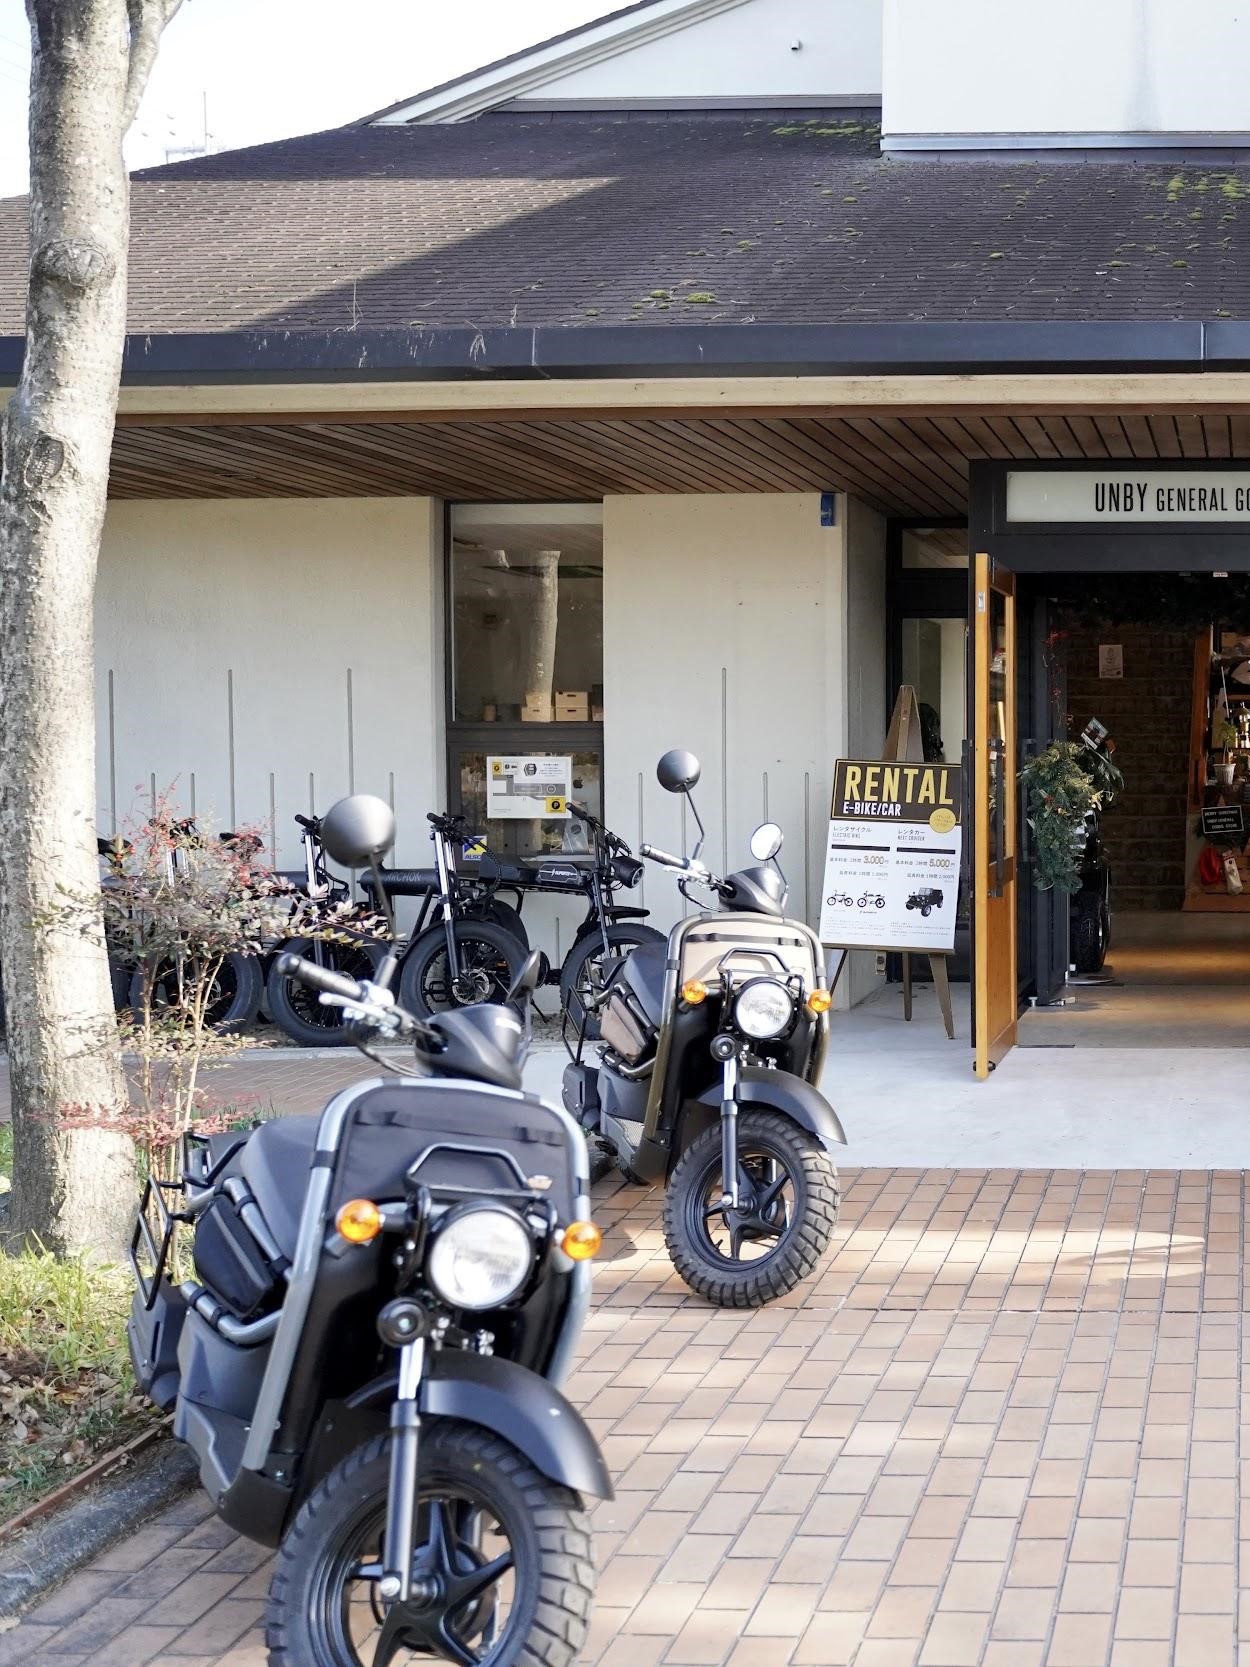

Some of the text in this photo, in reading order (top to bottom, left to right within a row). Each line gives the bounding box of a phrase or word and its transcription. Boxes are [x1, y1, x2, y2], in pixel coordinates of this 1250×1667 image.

[1095, 482, 1148, 512] UNBY
[1156, 487, 1228, 512] GENERAL
[844, 765, 953, 805] RENTAL
[843, 801, 902, 817] E-BIKE/CAR
[833, 825, 872, 833] レンタサイクル
